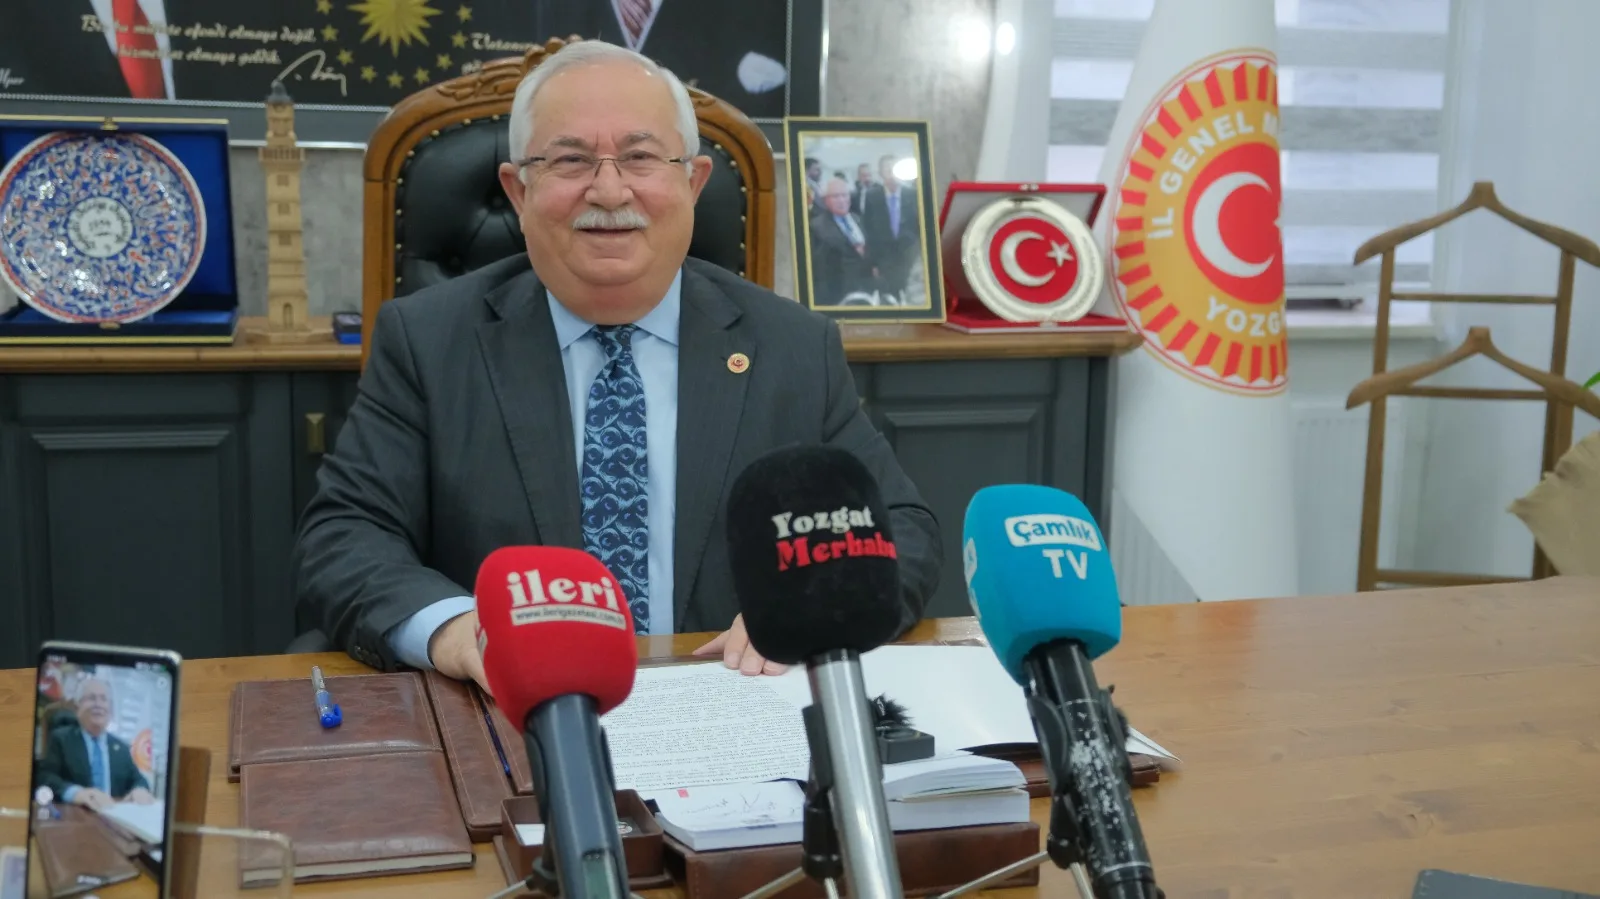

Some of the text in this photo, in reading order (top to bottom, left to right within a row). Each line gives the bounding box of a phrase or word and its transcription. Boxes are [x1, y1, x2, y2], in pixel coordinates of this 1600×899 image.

[1159, 110, 1255, 194] GENEL
[1206, 295, 1285, 337] YOZG
[771, 505, 875, 539] Yozgat
[1012, 519, 1095, 543] Çamlık
[1042, 548, 1088, 580] TV
[506, 569, 621, 612] ileri
